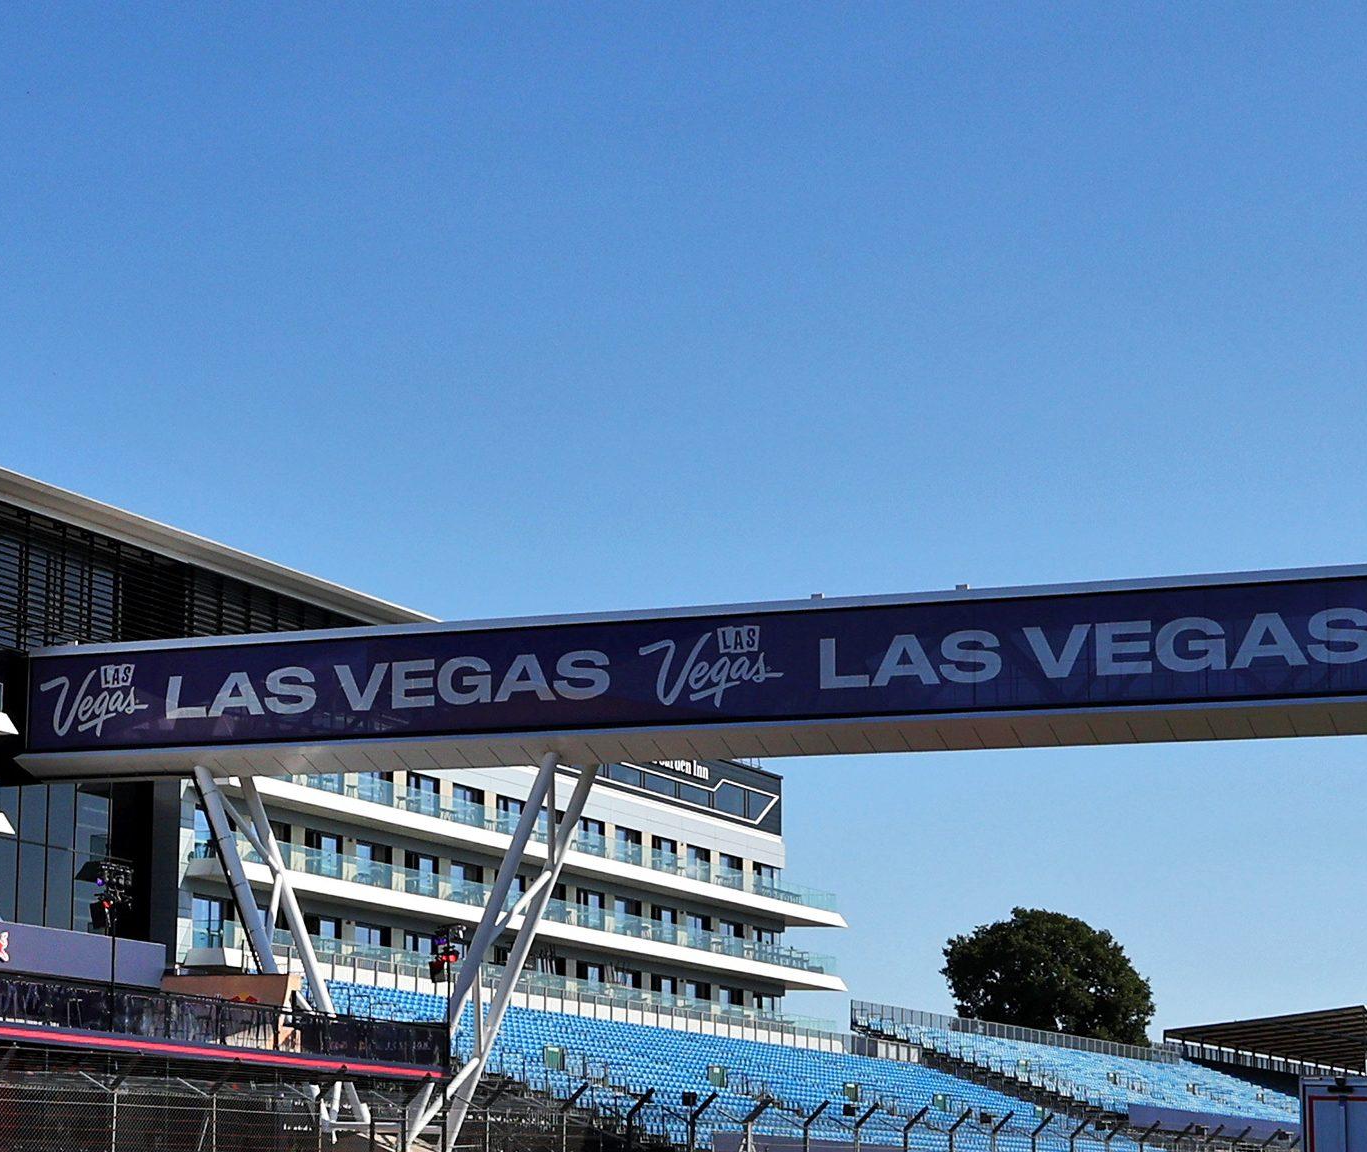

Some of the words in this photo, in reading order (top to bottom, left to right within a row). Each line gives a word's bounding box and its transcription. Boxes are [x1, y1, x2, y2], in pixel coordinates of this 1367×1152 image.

[638, 632, 784, 708] Vegas
[716, 625, 761, 653] LAS
[819, 629, 1003, 690] LAS
[40, 664, 149, 738] Vegas
[101, 664, 135, 689] LAS
[165, 667, 319, 721] LAS
[334, 650, 611, 711] VEGAS
